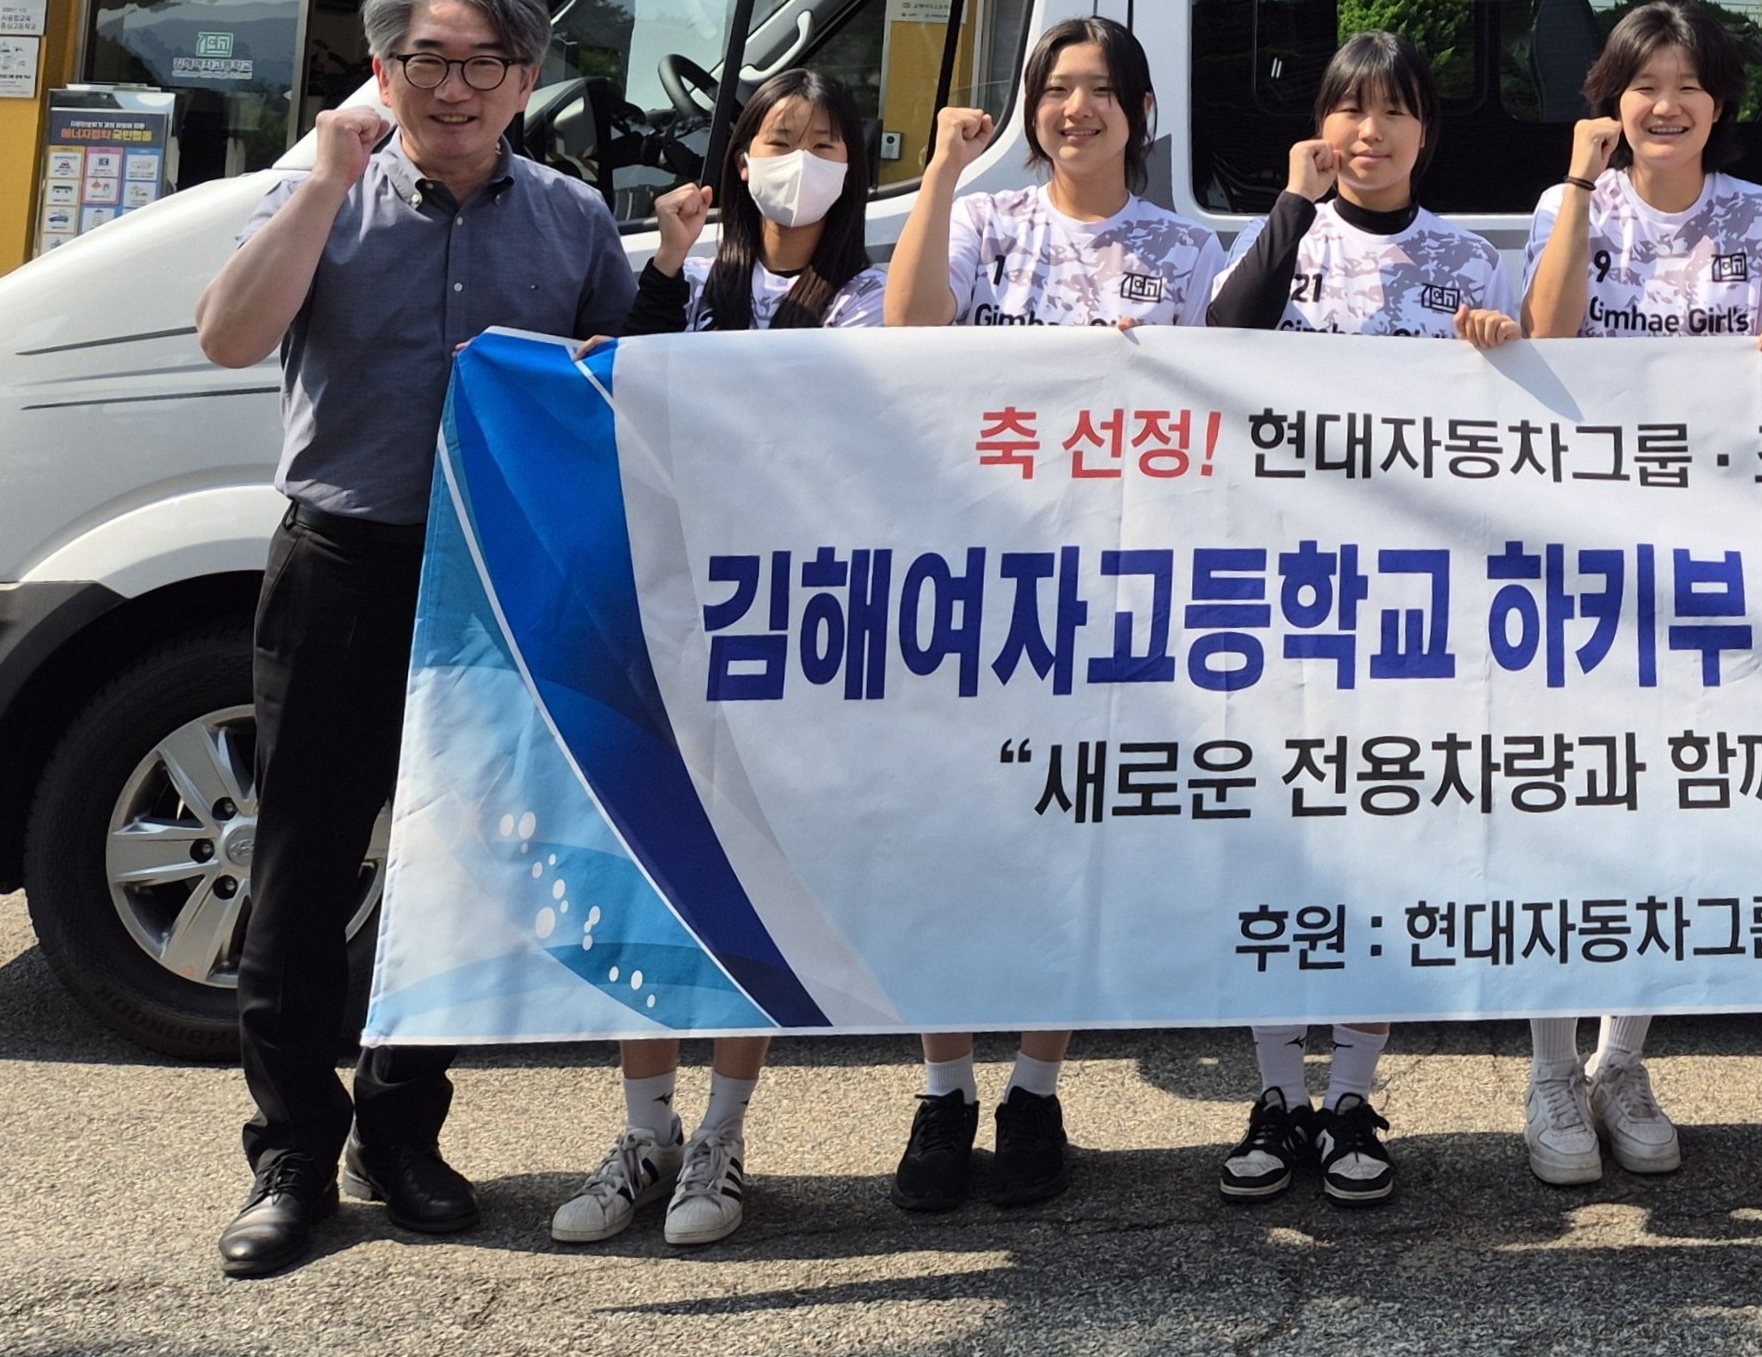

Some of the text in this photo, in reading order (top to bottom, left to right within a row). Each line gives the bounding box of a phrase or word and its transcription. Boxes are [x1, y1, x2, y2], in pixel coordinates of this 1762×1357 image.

[1290, 272, 1324, 304] 21
[1593, 249, 1612, 284] 9
[1688, 306, 1750, 334] Girl's
[977, 408, 1039, 479] 축
[1065, 410, 1221, 478] 선정!
[1248, 408, 1692, 488] 현대자동차그룹
[703, 541, 1455, 702] 김해여자고등학교
[1487, 541, 1752, 688] 하키부
[1000, 739, 1256, 823] “새로운
[1282, 733, 1646, 817] 전용차량과
[1236, 905, 1345, 972] 후원
